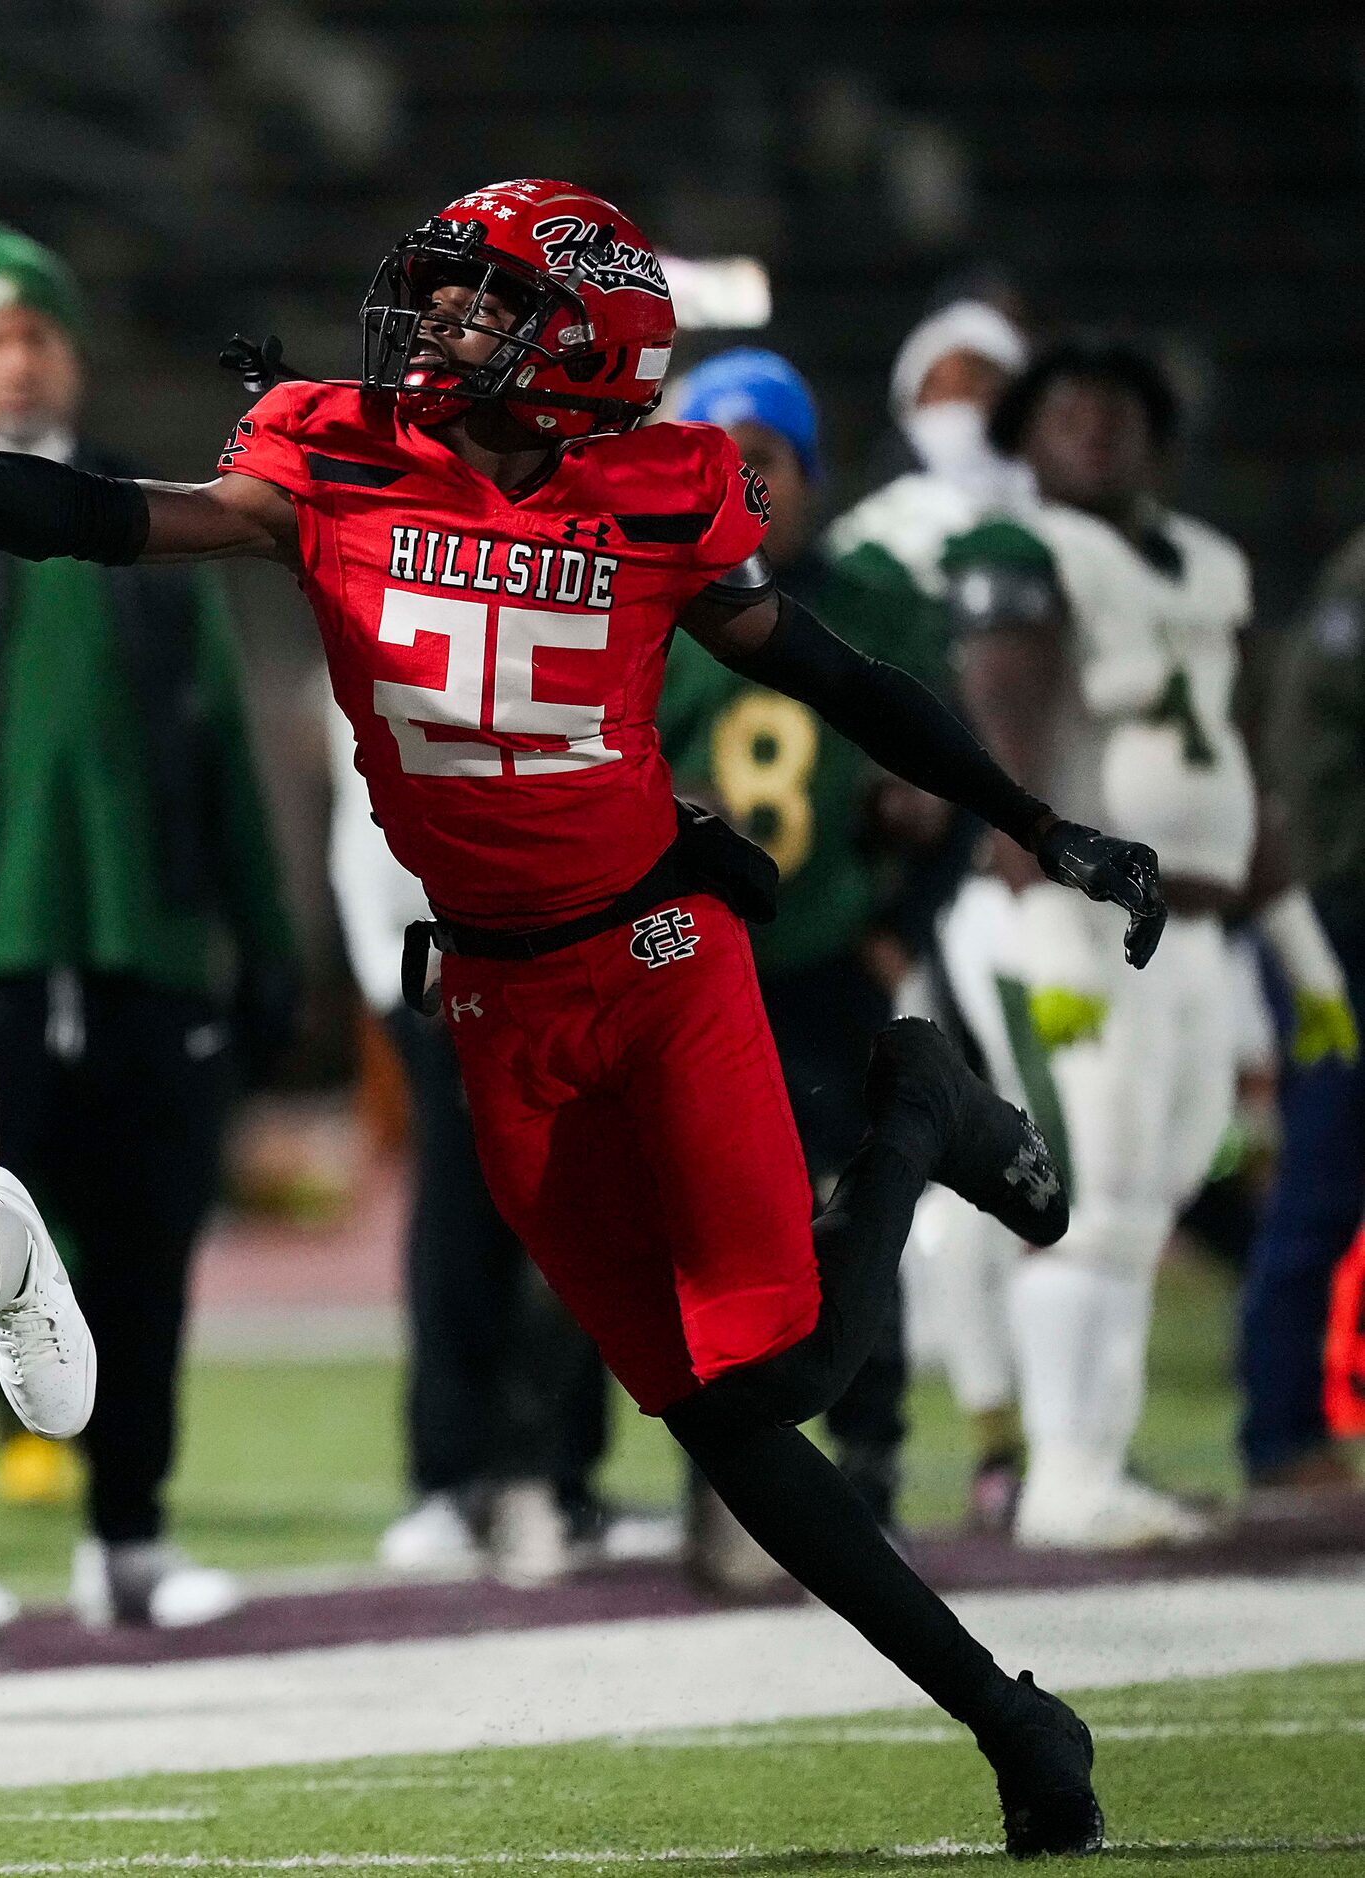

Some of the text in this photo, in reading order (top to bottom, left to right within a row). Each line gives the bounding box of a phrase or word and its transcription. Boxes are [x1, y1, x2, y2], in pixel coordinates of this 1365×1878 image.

[389, 525, 621, 612] HILLSIDE
[373, 586, 623, 777] 25
[713, 690, 819, 878] 8
